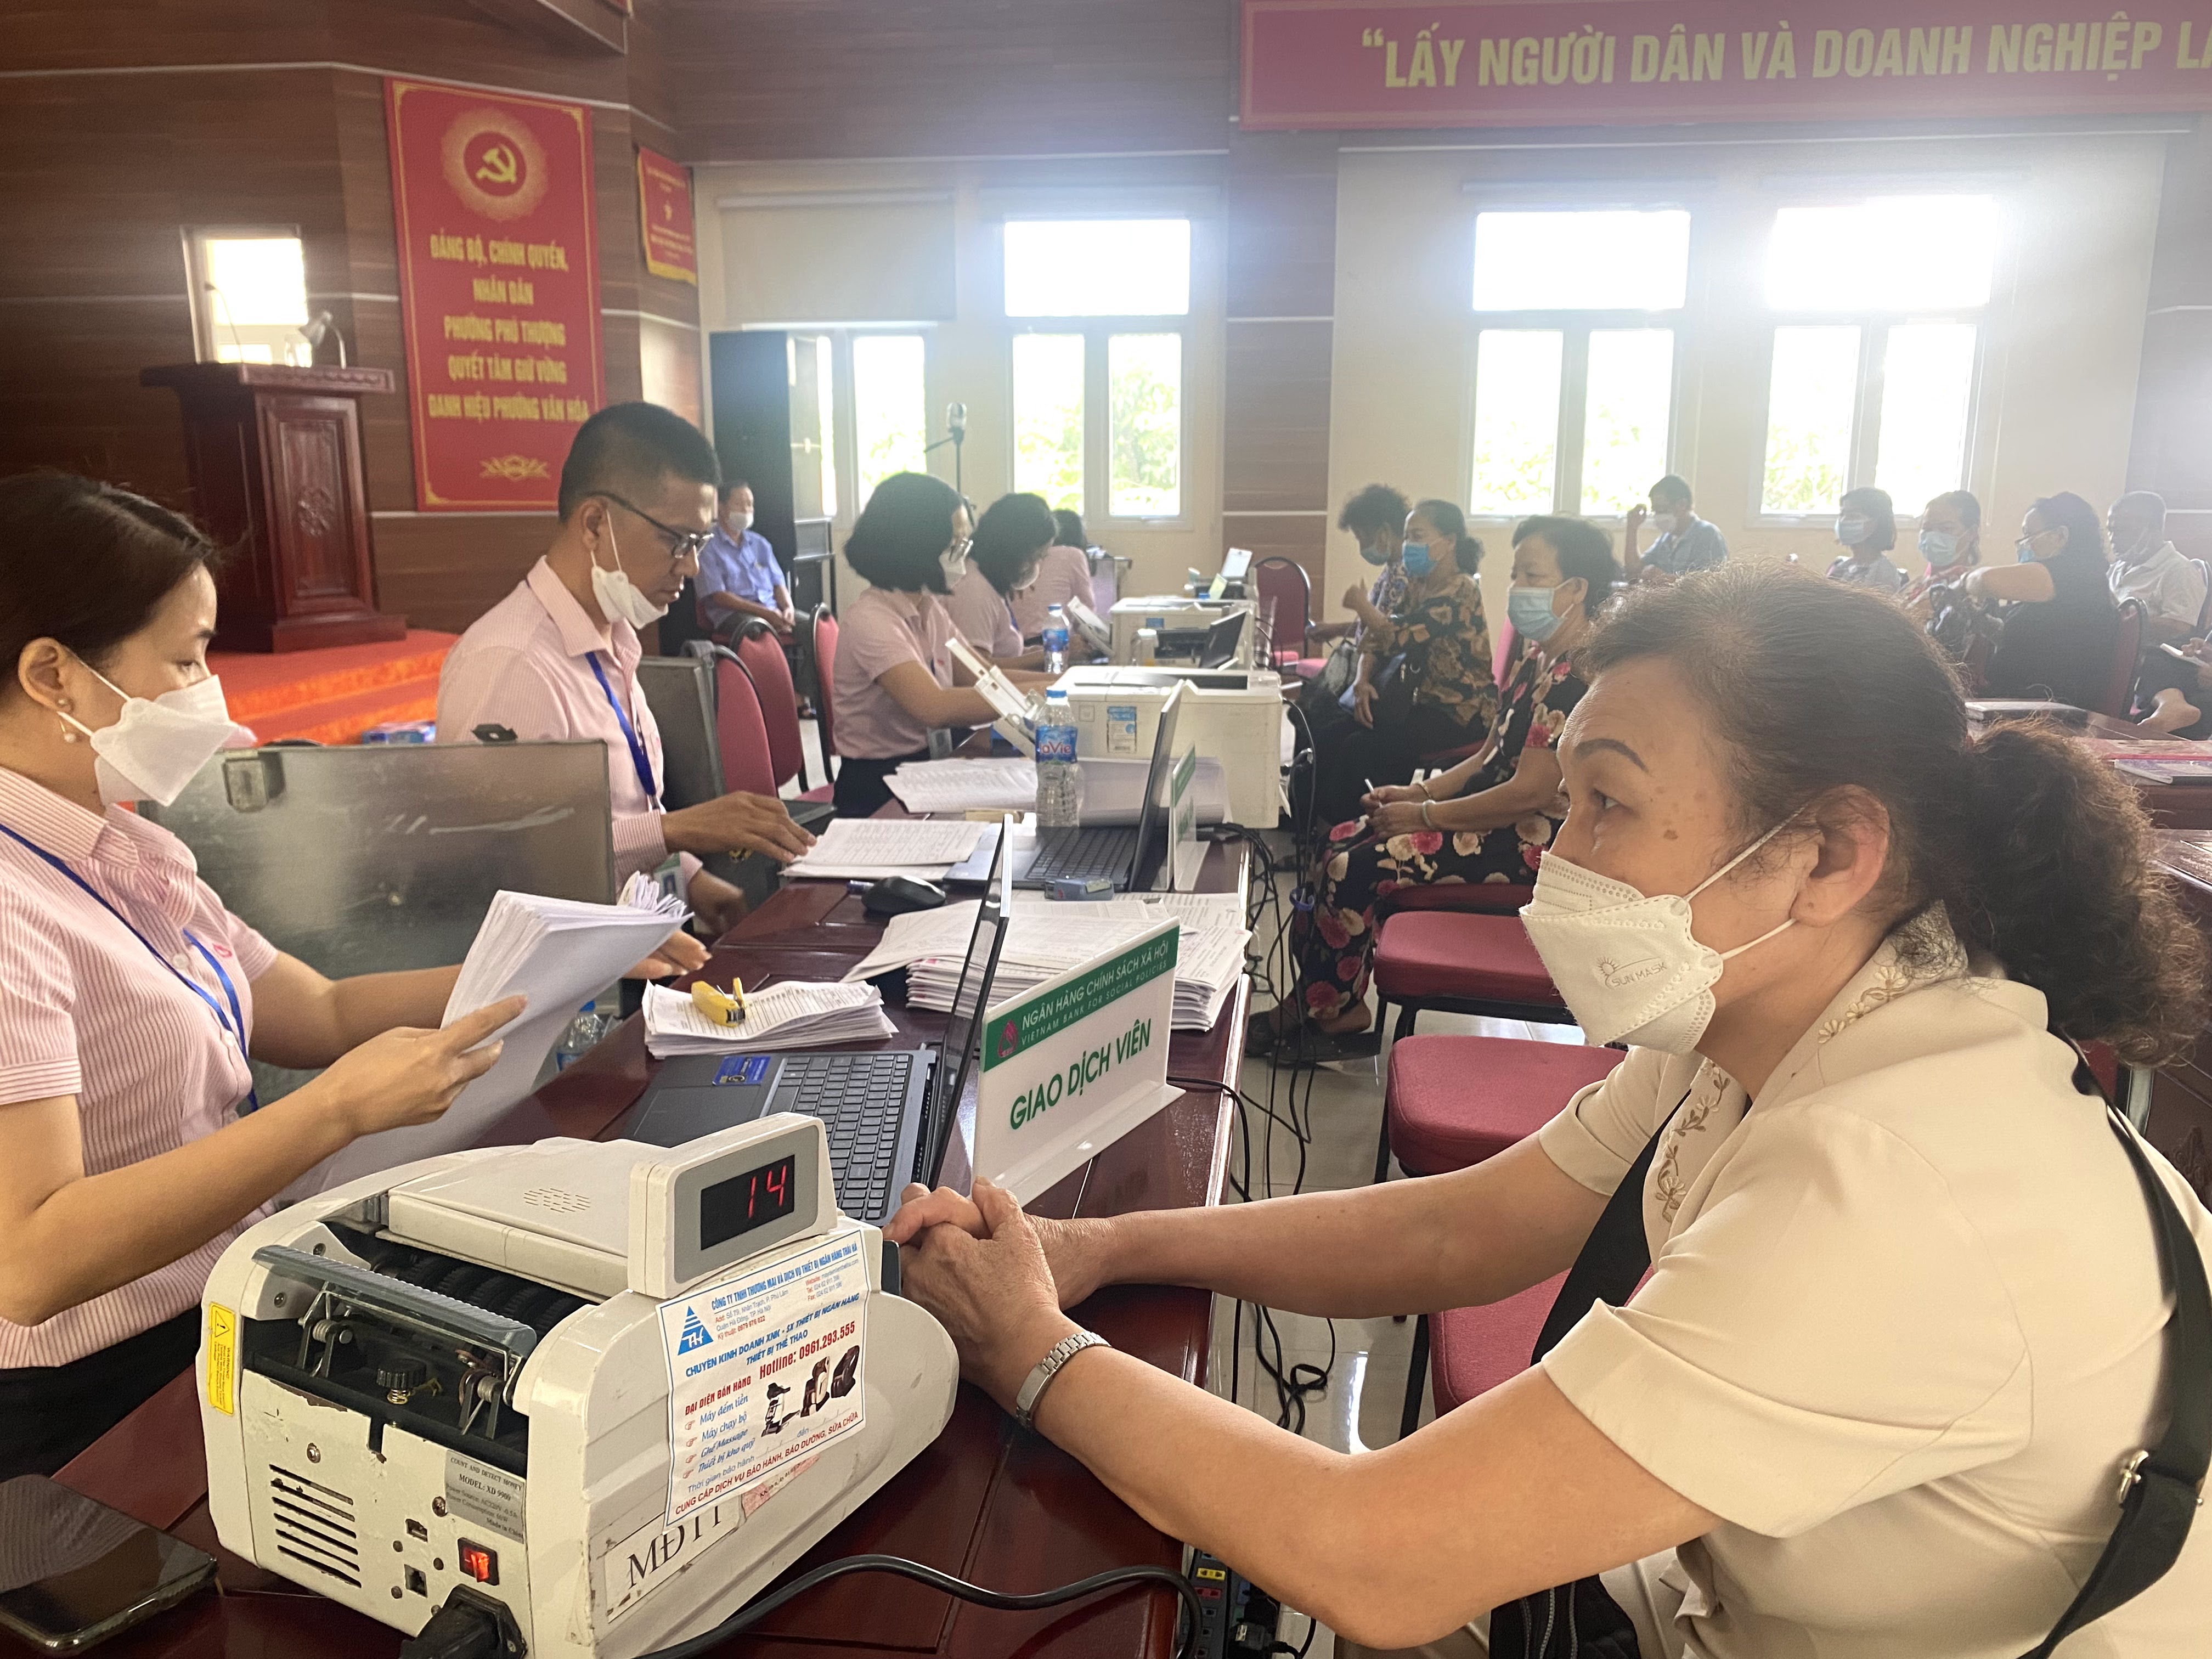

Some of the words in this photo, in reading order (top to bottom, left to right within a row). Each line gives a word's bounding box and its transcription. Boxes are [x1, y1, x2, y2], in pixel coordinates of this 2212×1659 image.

[1479, 24, 1616, 86] NGƯỜI
[1630, 23, 1725, 82] DÂN
[1741, 20, 1796, 80] VÀ
[1813, 26, 1973, 78] DOANH
[1987, 11, 2162, 81] NGHIỆP
[473, 274, 506, 303] NHÂN
[428, 393, 462, 418] DANH
[1022, 1001, 1054, 1030] NGÂN
[1056, 990, 1085, 1012] HÀNG
[1086, 970, 1115, 996] CHÍNH
[1116, 956, 1139, 980] SÁCH
[1141, 947, 1152, 966] XÃ
[1154, 940, 1169, 960] HỘI
[1612, 974, 1635, 987] SUN
[1635, 962, 1667, 980] MASK
[1022, 1018, 1059, 1045] VIETNAM
[1063, 1005, 1085, 1023] BANK
[1088, 998, 1102, 1009] FOR
[1106, 977, 1133, 1000] SOCIAL
[1136, 960, 1167, 984] POLICIES
[1010, 1073, 1063, 1130] GIAO
[1068, 1042, 1111, 1097] DỊCH
[1116, 1018, 1151, 1064] VIÊN
[748, 1165, 787, 1218] 14
[726, 1294, 732, 1304] TY
[686, 1357, 717, 1378] CHUYÊN
[719, 1348, 737, 1365] KINH
[739, 1336, 764, 1356] DOANH
[841, 1293, 860, 1306] HÀNG
[760, 1351, 797, 1379] Hotline:
[799, 1321, 855, 1360] 0961.293.555
[790, 1329, 808, 1345] THAO
[699, 1392, 715, 1407] DIỆN
[717, 1385, 731, 1400] BÁN
[733, 1375, 751, 1392] HÀNG
[700, 1410, 716, 1425] Máy
[702, 1427, 718, 1442] Máy
[720, 1418, 737, 1431] chạy
[738, 1411, 747, 1424] bộ
[450, 1457, 468, 1468] COUNT
[470, 1465, 480, 1474] AND
[482, 1470, 501, 1482] DETECT
[503, 1479, 522, 1492] MONEY
[675, 1497, 696, 1515] CUNG
[715, 1477, 733, 1493] DỊCH
[734, 1472, 745, 1483] VỤ
[747, 1464, 761, 1477] BẢO
[843, 1411, 859, 1425] CHỮA
[705, 1472, 721, 1486] gian
[737, 1455, 755, 1469] hành
[459, 1474, 485, 1491] MODEL:
[486, 1485, 496, 1495] XD
